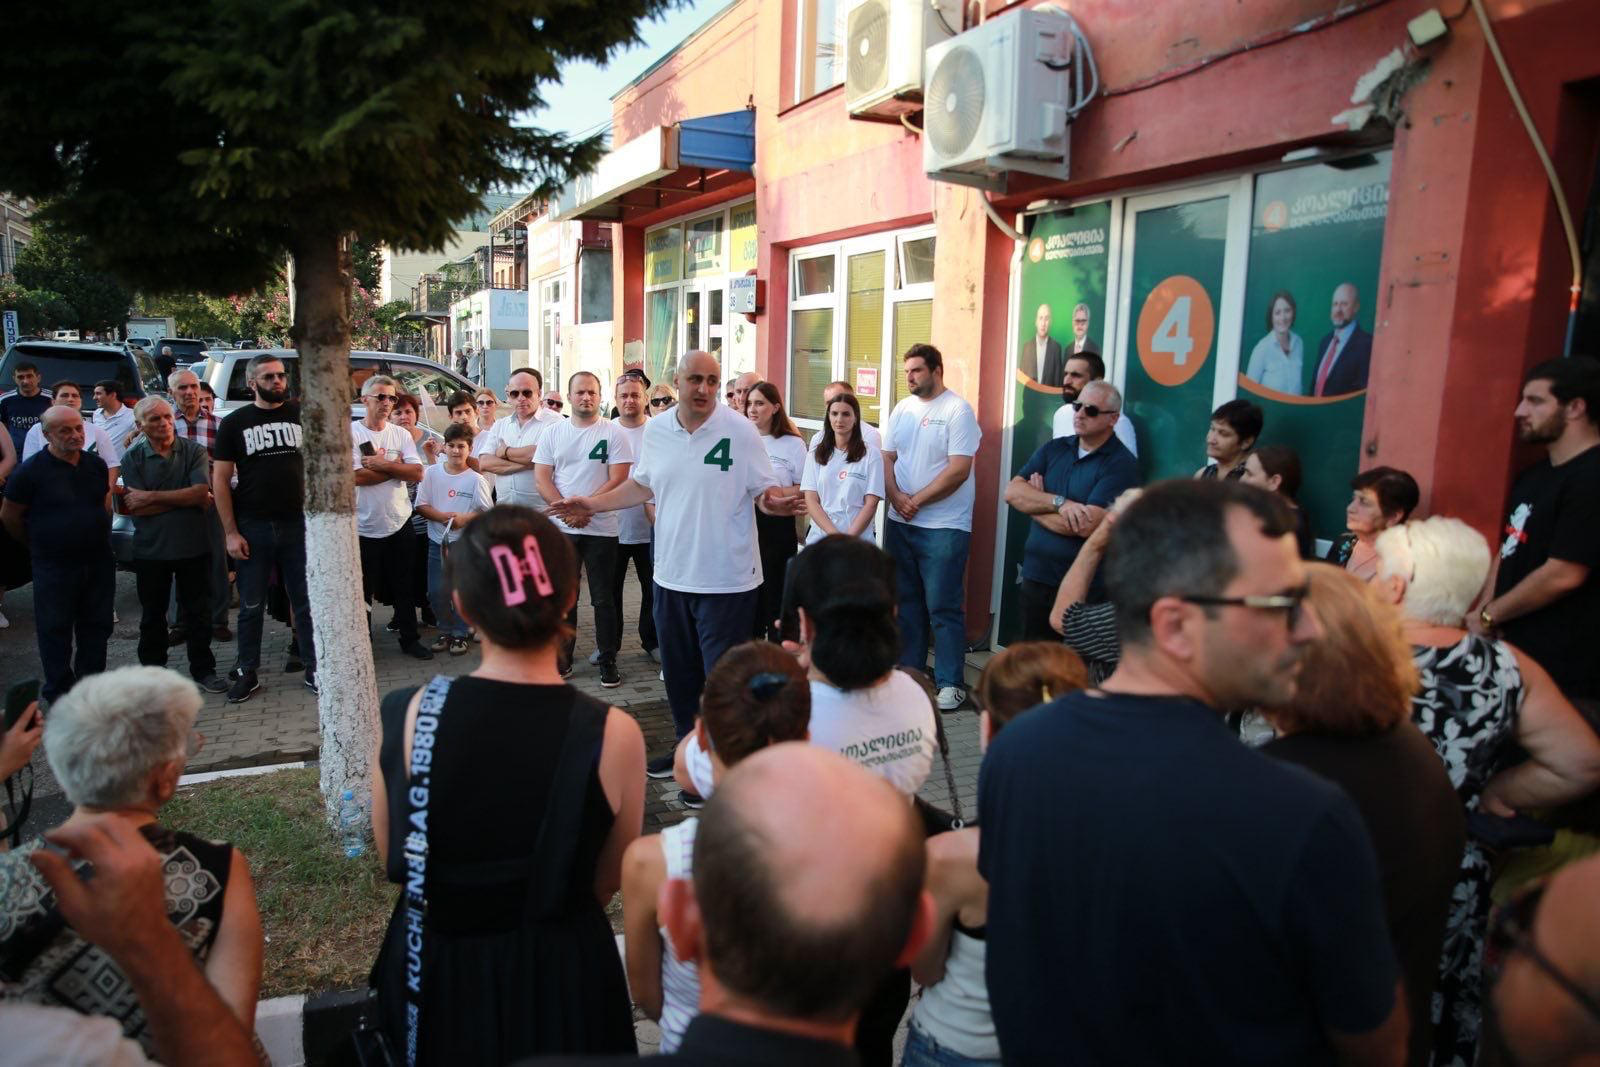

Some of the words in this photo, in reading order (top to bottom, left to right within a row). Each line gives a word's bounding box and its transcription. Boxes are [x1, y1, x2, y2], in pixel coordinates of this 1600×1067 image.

[1045, 228, 1105, 251] კოალიცია
[1151, 295, 1194, 365] 4
[588, 439, 609, 464] 4
[703, 437, 734, 472] 4
[839, 727, 924, 759] ოალიცია
